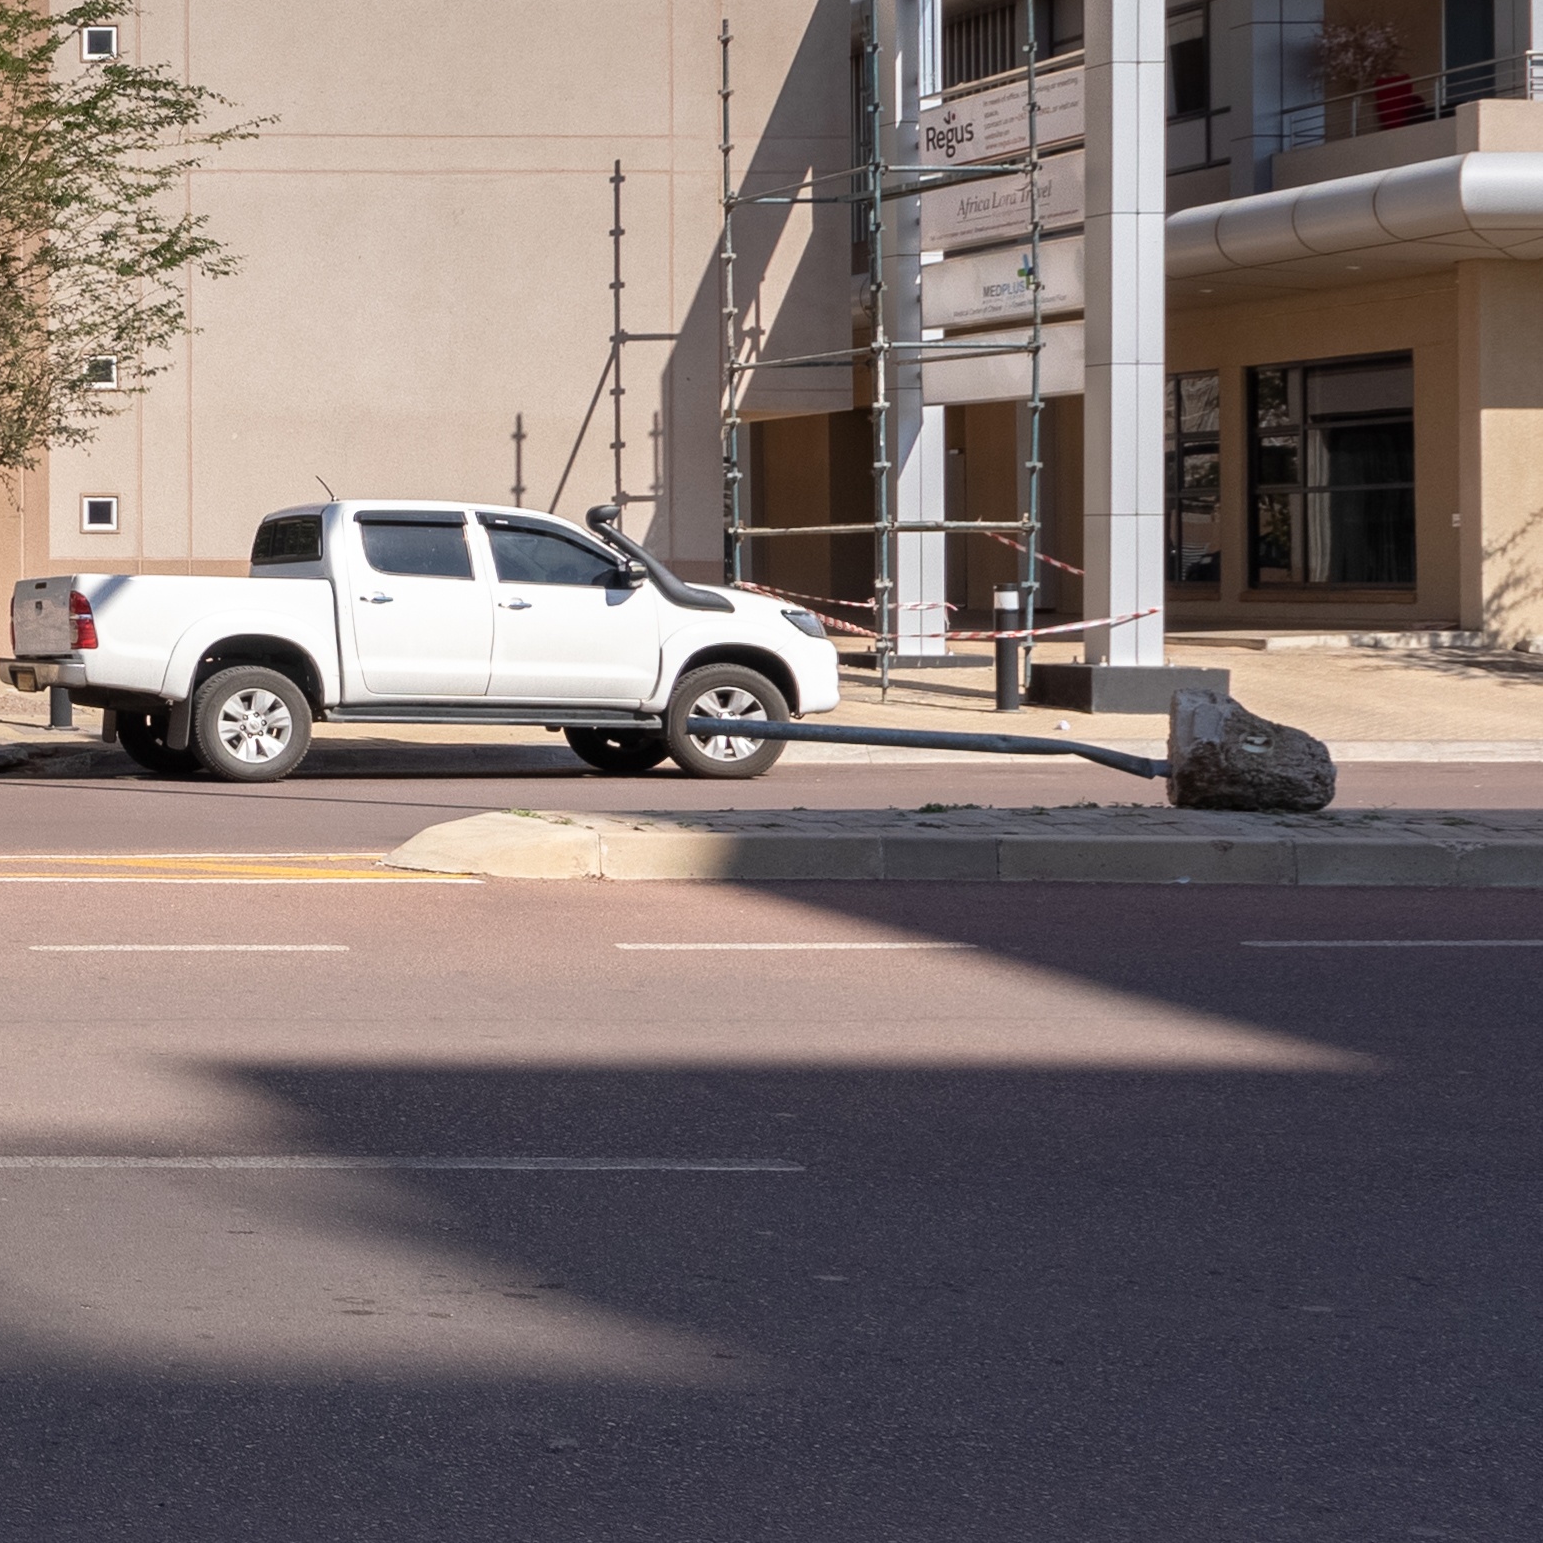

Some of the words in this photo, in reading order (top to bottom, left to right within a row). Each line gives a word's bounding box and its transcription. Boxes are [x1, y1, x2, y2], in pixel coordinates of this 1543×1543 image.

[925, 122, 975, 158] Regus
[957, 196, 990, 218] Africa
[991, 191, 1016, 208] Lora
[983, 280, 1026, 298] MEDPLUS
